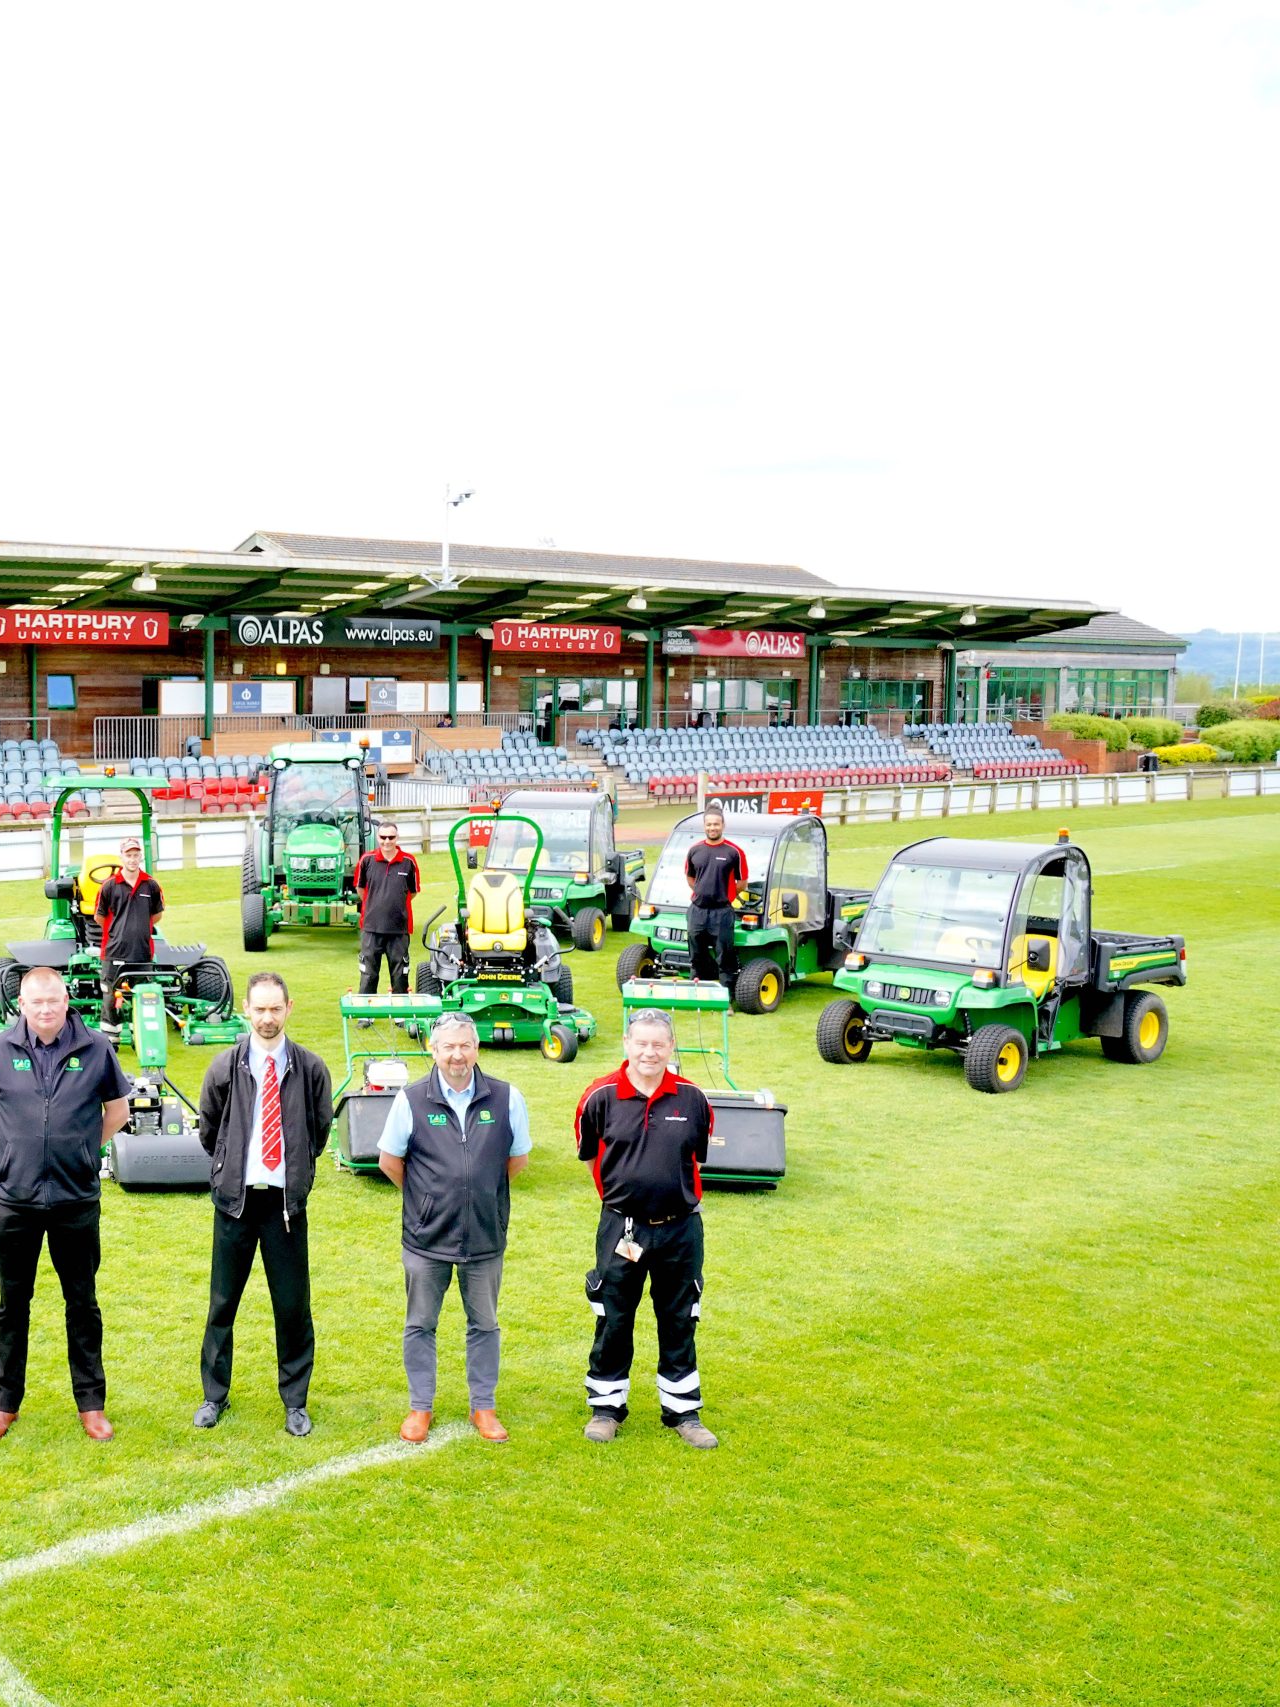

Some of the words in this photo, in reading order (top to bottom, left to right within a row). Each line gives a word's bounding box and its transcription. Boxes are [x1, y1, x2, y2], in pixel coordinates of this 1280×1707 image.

[15, 613, 137, 630] HARTPURY
[18, 631, 132, 641] UNIVERSITY
[260, 619, 324, 645] ALPAS
[345, 621, 434, 646] www.alpas.eu
[518, 626, 600, 640] HARTPURY
[519, 641, 596, 650] COLLEGE
[760, 635, 800, 655] ALPAS
[427, 1114, 447, 1123] TAG
